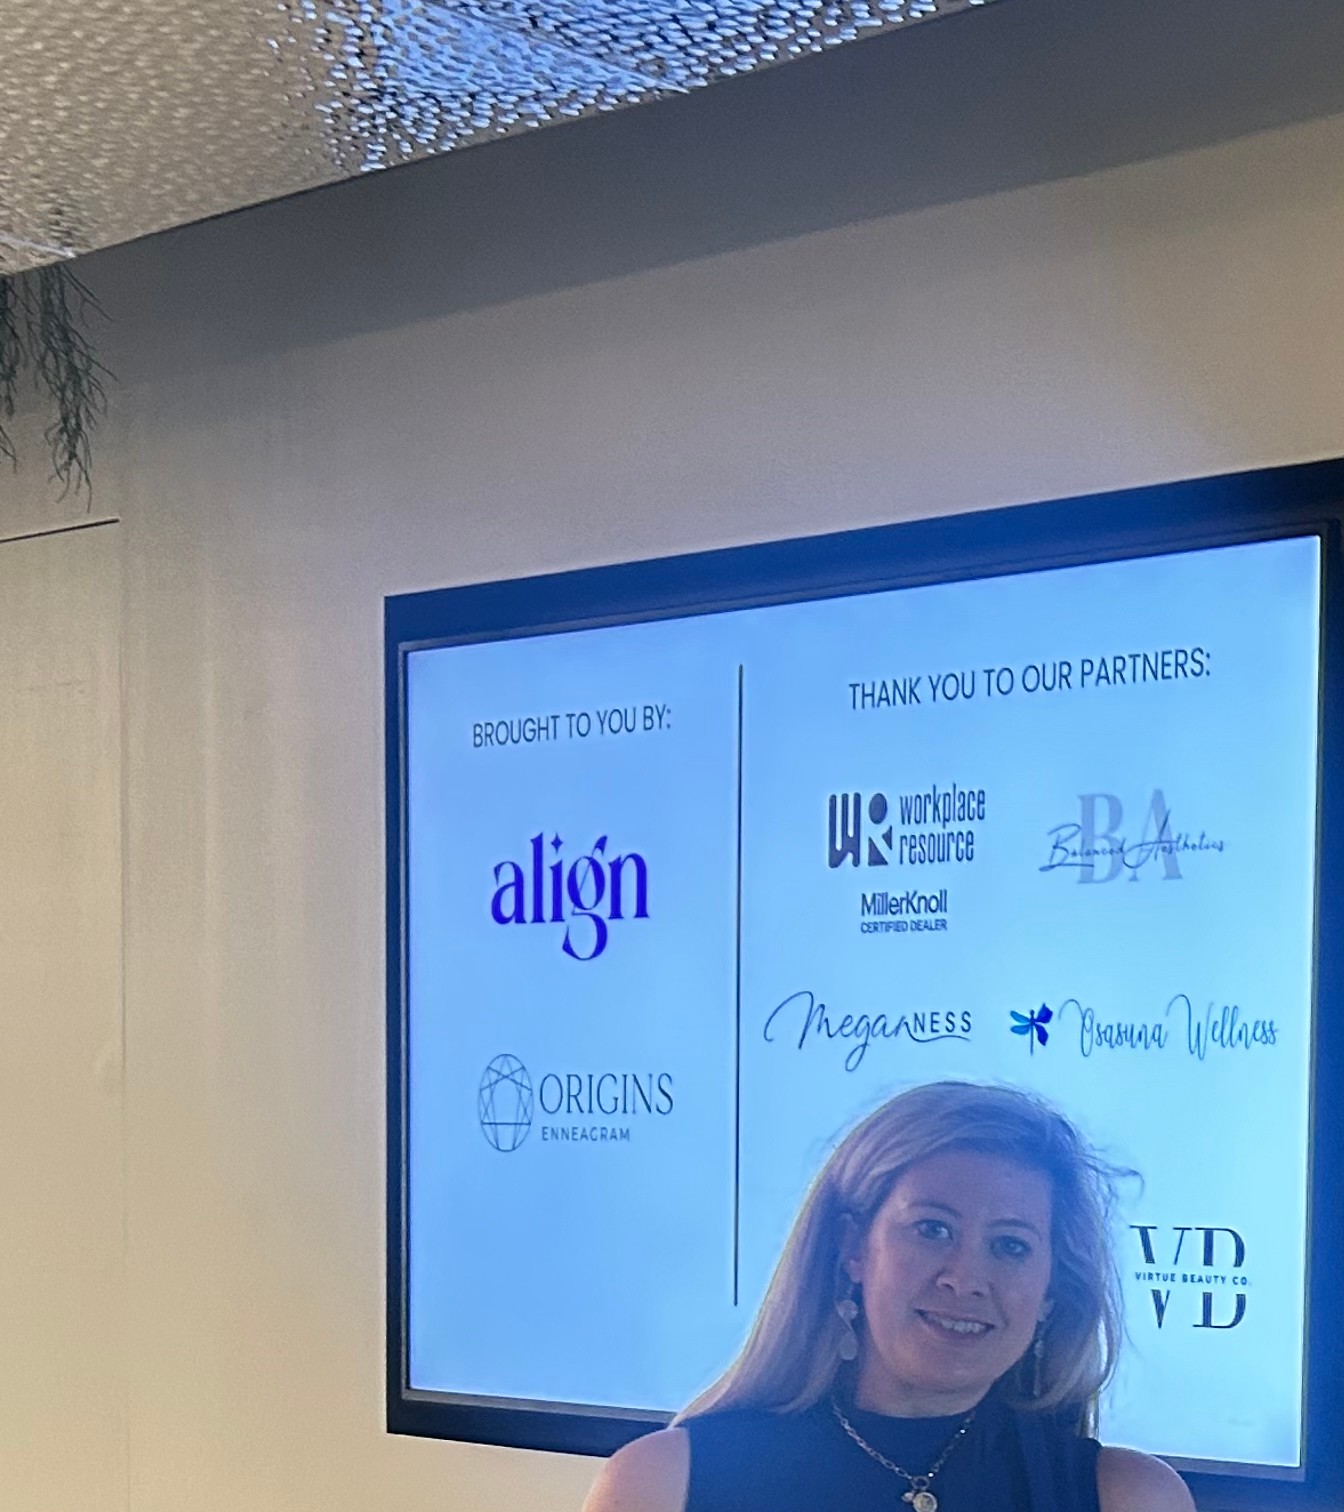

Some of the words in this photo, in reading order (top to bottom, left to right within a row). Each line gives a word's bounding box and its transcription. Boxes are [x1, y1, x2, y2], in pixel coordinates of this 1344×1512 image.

[849, 676, 922, 711] THANK
[927, 669, 976, 703] YOU
[983, 665, 1015, 697] TO
[1021, 661, 1073, 693] OUR
[1079, 647, 1212, 690] PARTNERS:
[472, 714, 561, 748] BROUGHT
[566, 711, 592, 739] TO
[596, 707, 637, 736] YOU
[643, 703, 672, 731] BY:
[899, 781, 986, 830] workplace
[899, 829, 975, 866] resource
[490, 831, 650, 961] align
[860, 888, 948, 917] MillerKnoll
[860, 919, 908, 934] CERTIFIED
[910, 918, 948, 932] DEALER
[1166, 993, 1278, 1061] Wellness
[539, 1072, 674, 1115] ORIGINS
[542, 1126, 631, 1142] ENNEAGRAM
[1135, 1272, 1176, 1283] VIRTUE
[1182, 1273, 1227, 1285] BEAUTY
